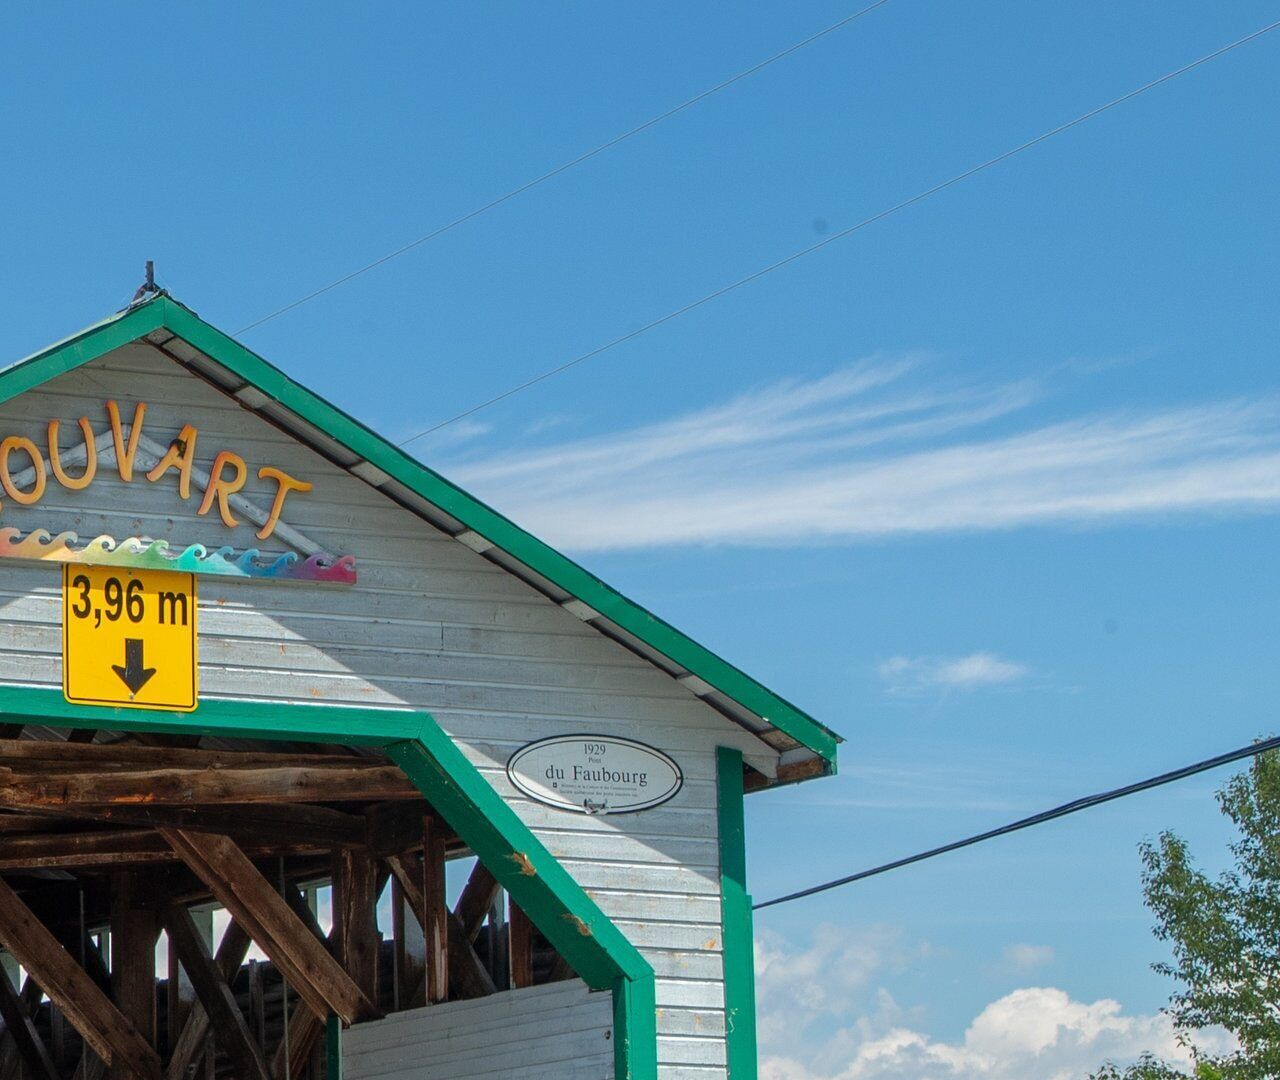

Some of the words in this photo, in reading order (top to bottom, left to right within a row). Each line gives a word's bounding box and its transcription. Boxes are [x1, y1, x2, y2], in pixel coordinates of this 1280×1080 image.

[72, 575, 145, 629] 3,96
[158, 590, 188, 626] m
[584, 743, 606, 755] 1929
[545, 765, 564, 779] du
[573, 765, 648, 786] Faubourg
